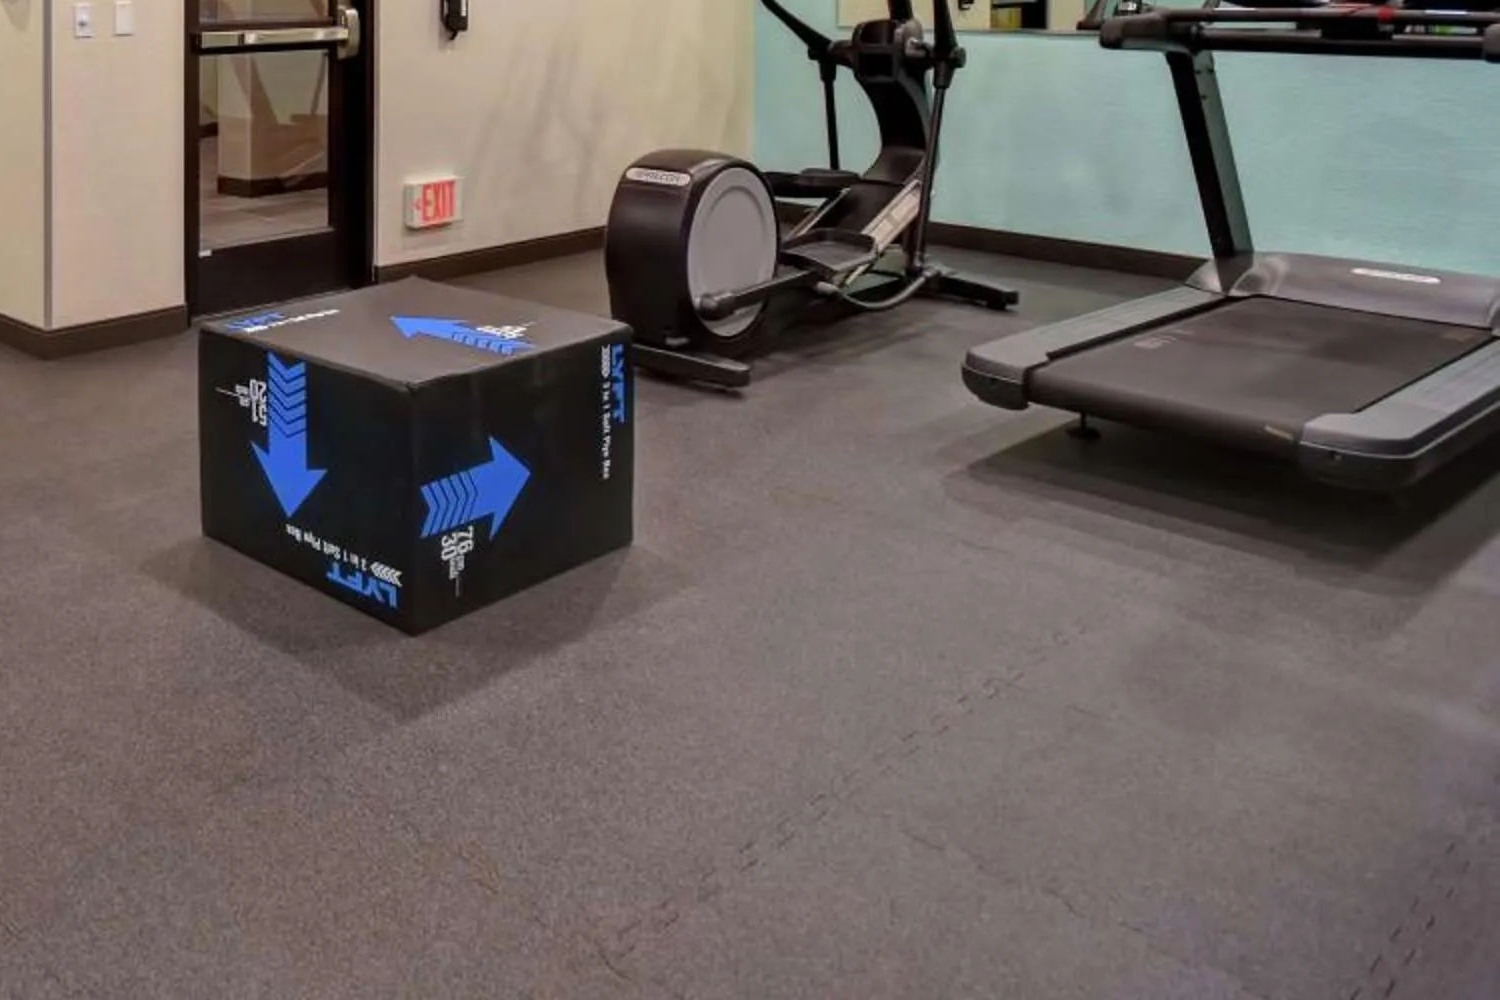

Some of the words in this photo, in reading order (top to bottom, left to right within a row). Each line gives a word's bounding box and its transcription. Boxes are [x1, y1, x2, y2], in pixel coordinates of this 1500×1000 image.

[422, 180, 454, 222] EXIT
[611, 343, 626, 424] LYFT
[441, 532, 457, 561] 30
[456, 525, 474, 555] 76
[325, 561, 398, 610] LYFT
